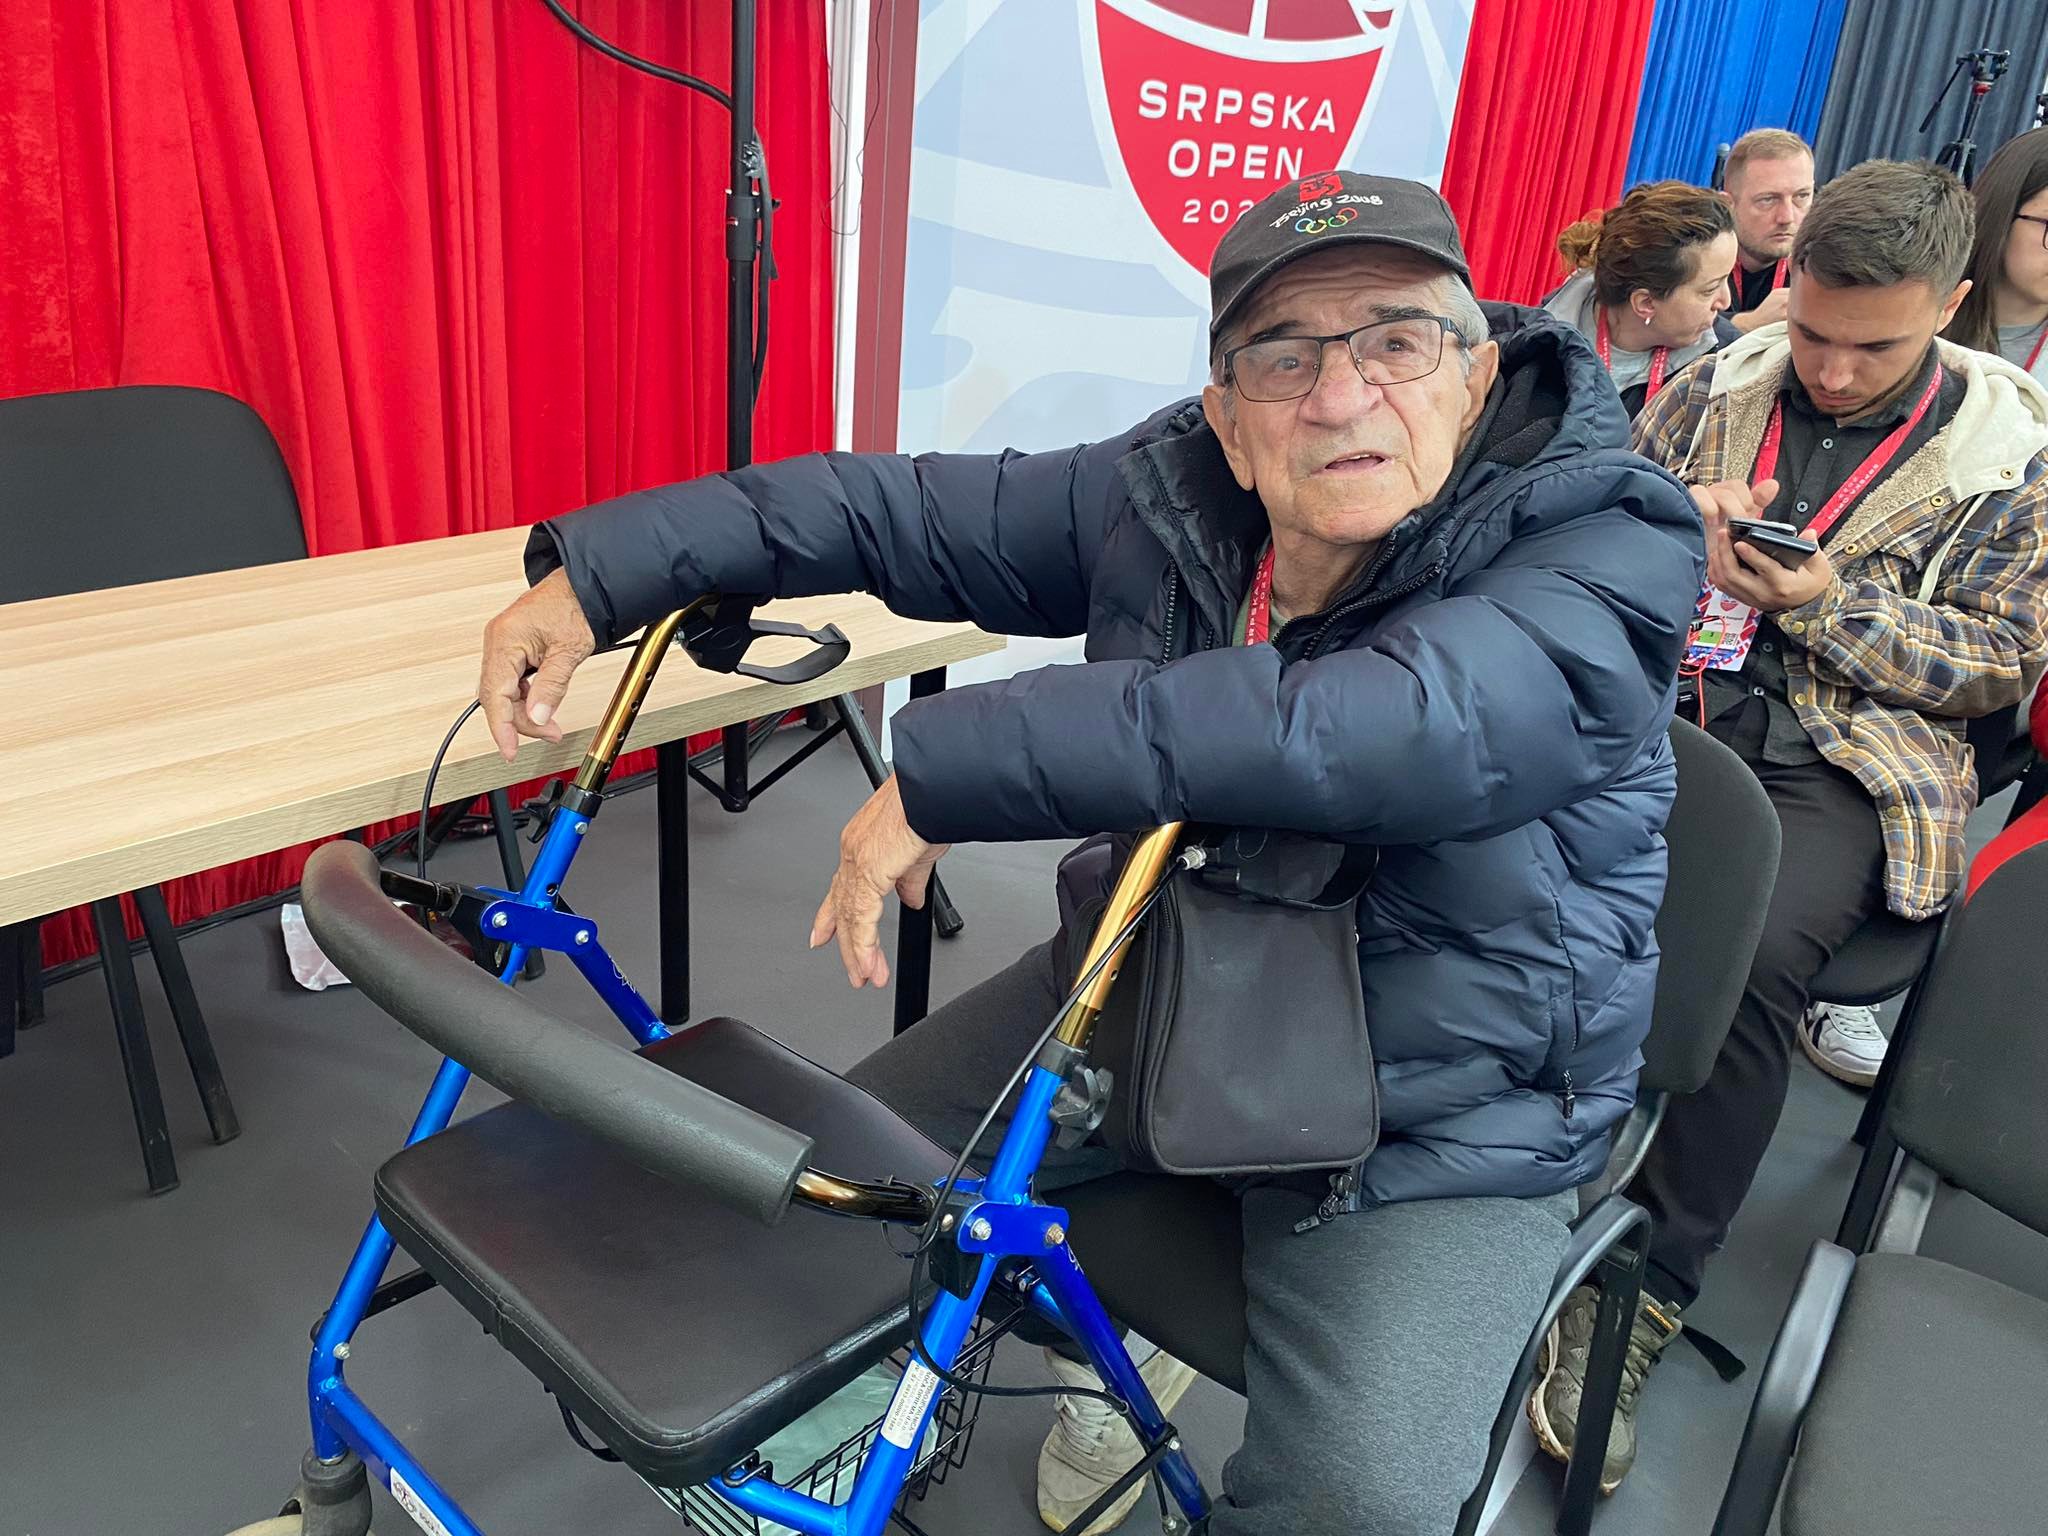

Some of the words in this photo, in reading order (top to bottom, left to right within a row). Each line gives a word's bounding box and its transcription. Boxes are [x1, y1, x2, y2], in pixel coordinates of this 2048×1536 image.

[1138, 79, 1336, 133] SRPSKA
[1168, 139, 1303, 181] OPEN
[1182, 199, 1254, 223] 202
[1269, 198, 1332, 228] Beijing
[1335, 194, 1383, 206] 2008
[1247, 586, 1260, 646] SRPSKA
